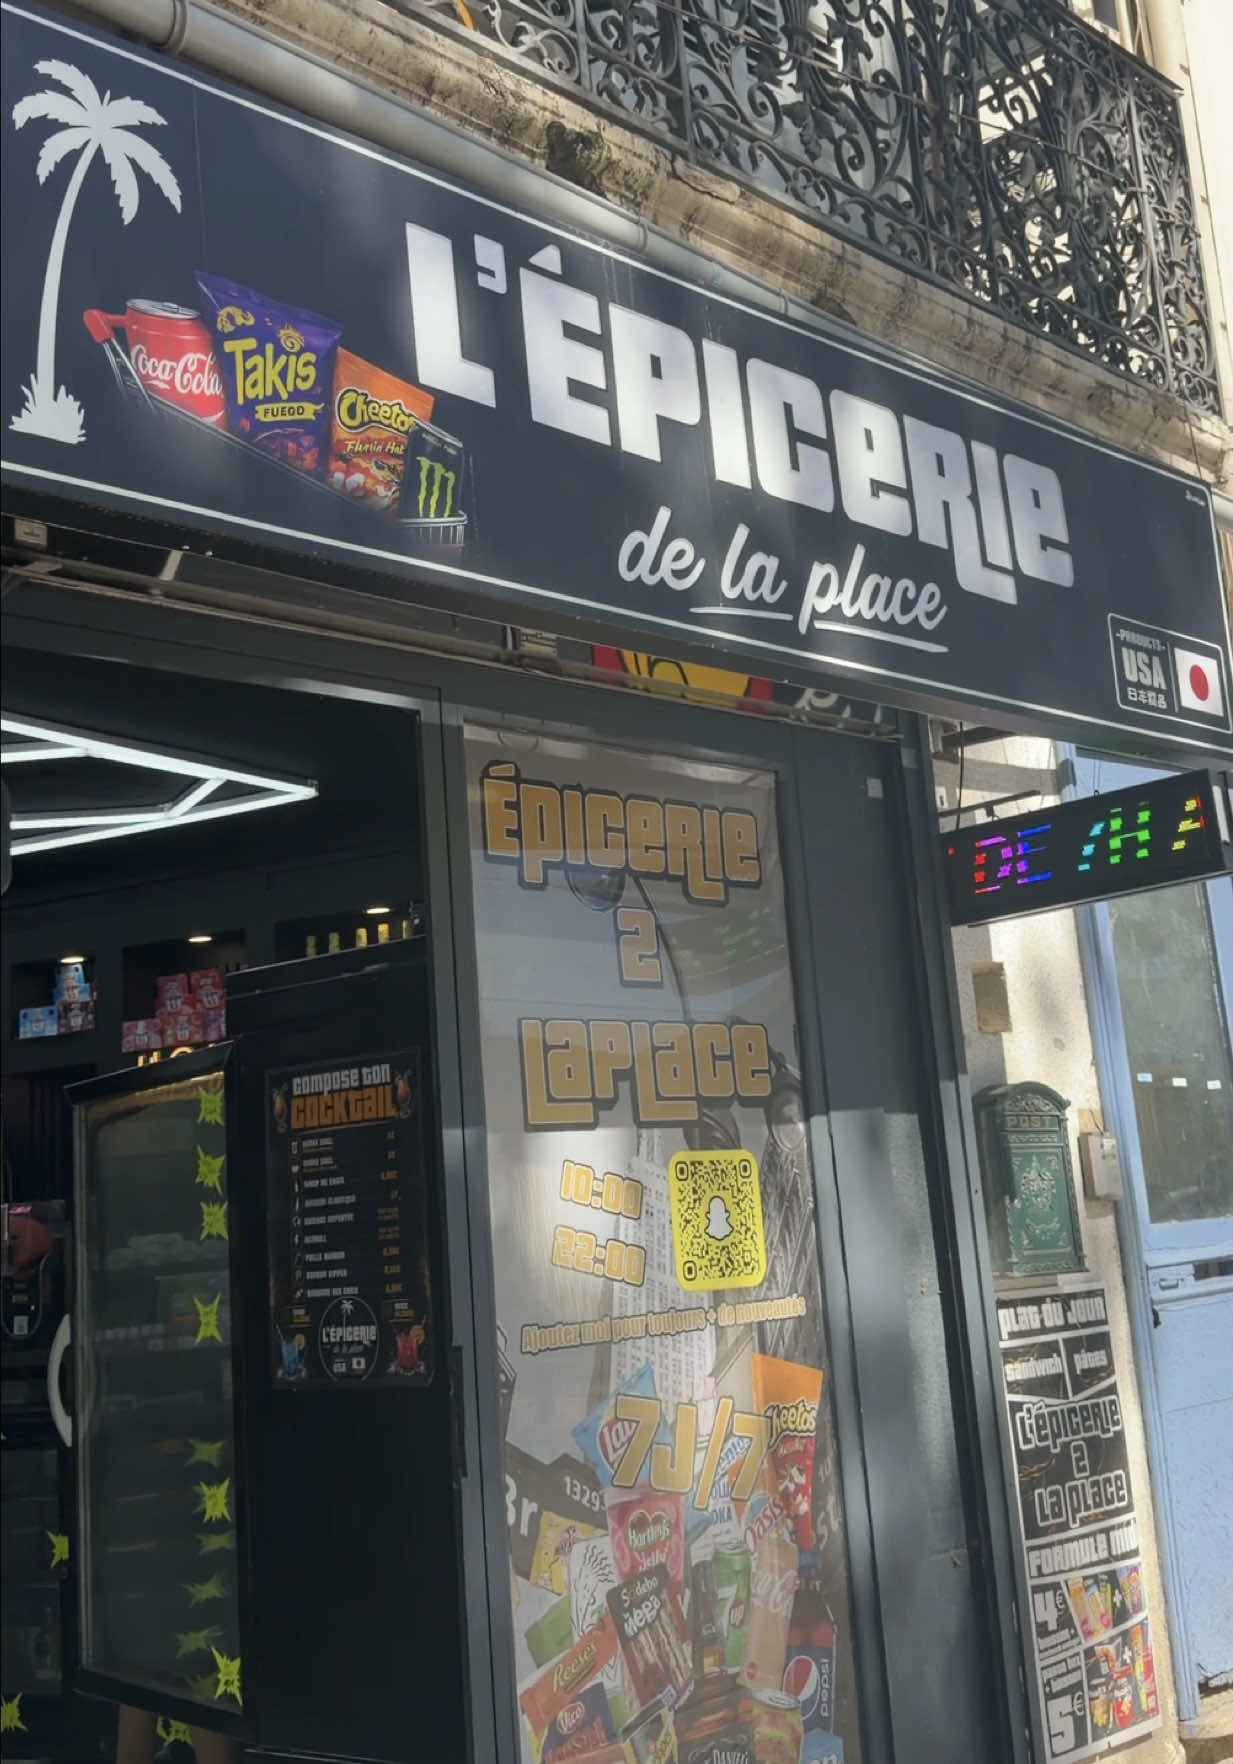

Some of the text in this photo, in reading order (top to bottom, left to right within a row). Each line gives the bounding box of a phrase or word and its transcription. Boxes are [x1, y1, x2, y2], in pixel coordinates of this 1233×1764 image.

[223, 337, 317, 405] Takis
[263, 405, 305, 418] FUEGO
[338, 388, 415, 433] Cheeto
[617, 506, 948, 634] de la place
[1121, 646, 1167, 691] USA
[615, 906, 662, 988] 2
[560, 1160, 643, 1220] 10:00
[552, 1225, 646, 1287] 22:00
[647, 1307, 706, 1336] toujours
[716, 1303, 736, 1327] de
[764, 1399, 817, 1446] heetos
[611, 1393, 770, 1511] 7J/7
[1071, 1441, 1090, 1478] 2
